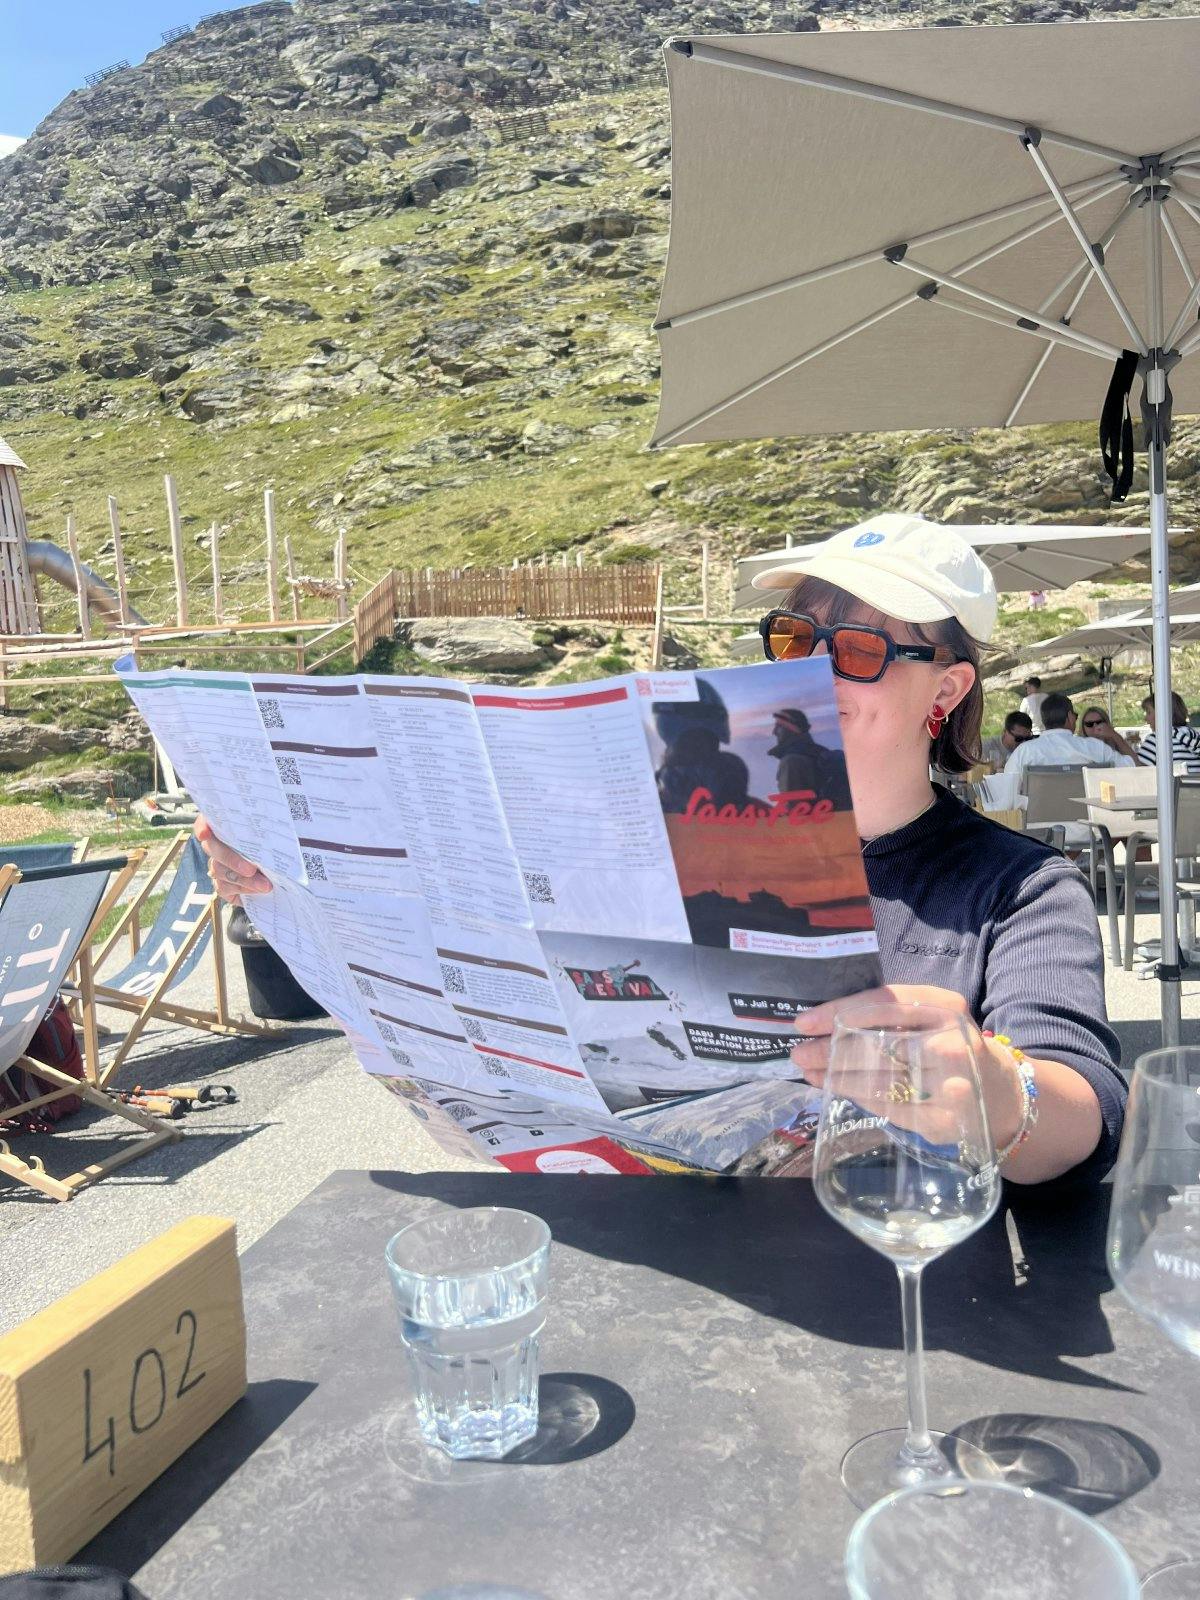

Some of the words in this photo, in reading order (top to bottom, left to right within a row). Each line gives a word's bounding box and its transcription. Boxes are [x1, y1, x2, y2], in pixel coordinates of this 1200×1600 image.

[750, 1000, 768, 1008] Juli
[689, 1028, 714, 1038] DABU
[719, 1033, 771, 1045] FANTASTIC
[691, 1036, 742, 1050] OPERATION
[82, 1309, 206, 1476] 402
